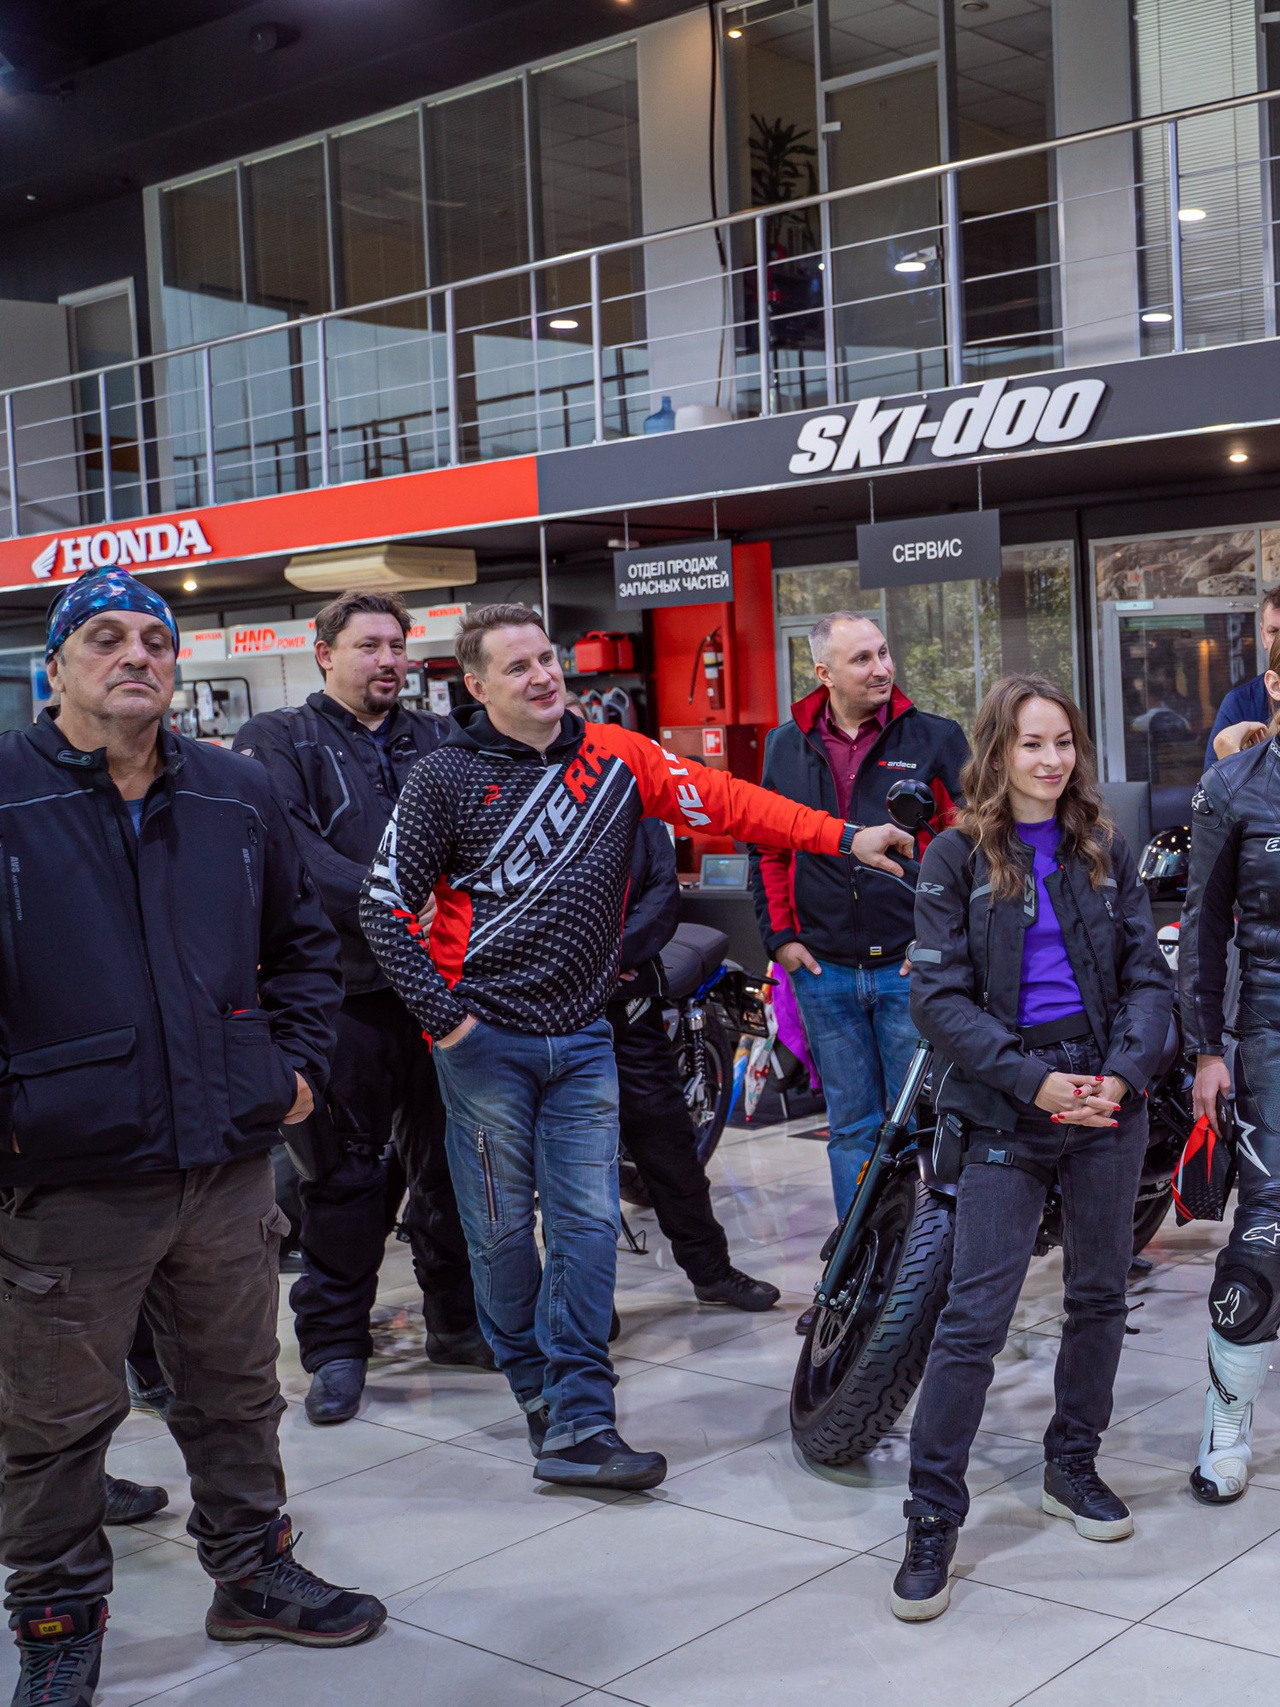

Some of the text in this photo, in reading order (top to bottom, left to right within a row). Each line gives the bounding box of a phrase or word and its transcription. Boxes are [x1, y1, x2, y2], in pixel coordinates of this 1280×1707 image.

[60, 518, 212, 574] HONDA
[892, 538, 963, 563] СЕРВИС
[627, 556, 718, 579] ОТДЕЛ ПРОДАЖ
[619, 570, 729, 598] ЗАПАСНЫХ ЧАСТЕЙ
[428, 606, 462, 618] HONDA
[234, 627, 306, 653] HND POWER
[10, 856, 20, 873] AVS
[242, 848, 251, 864] AVS
[1023, 874, 1035, 917] LS2
